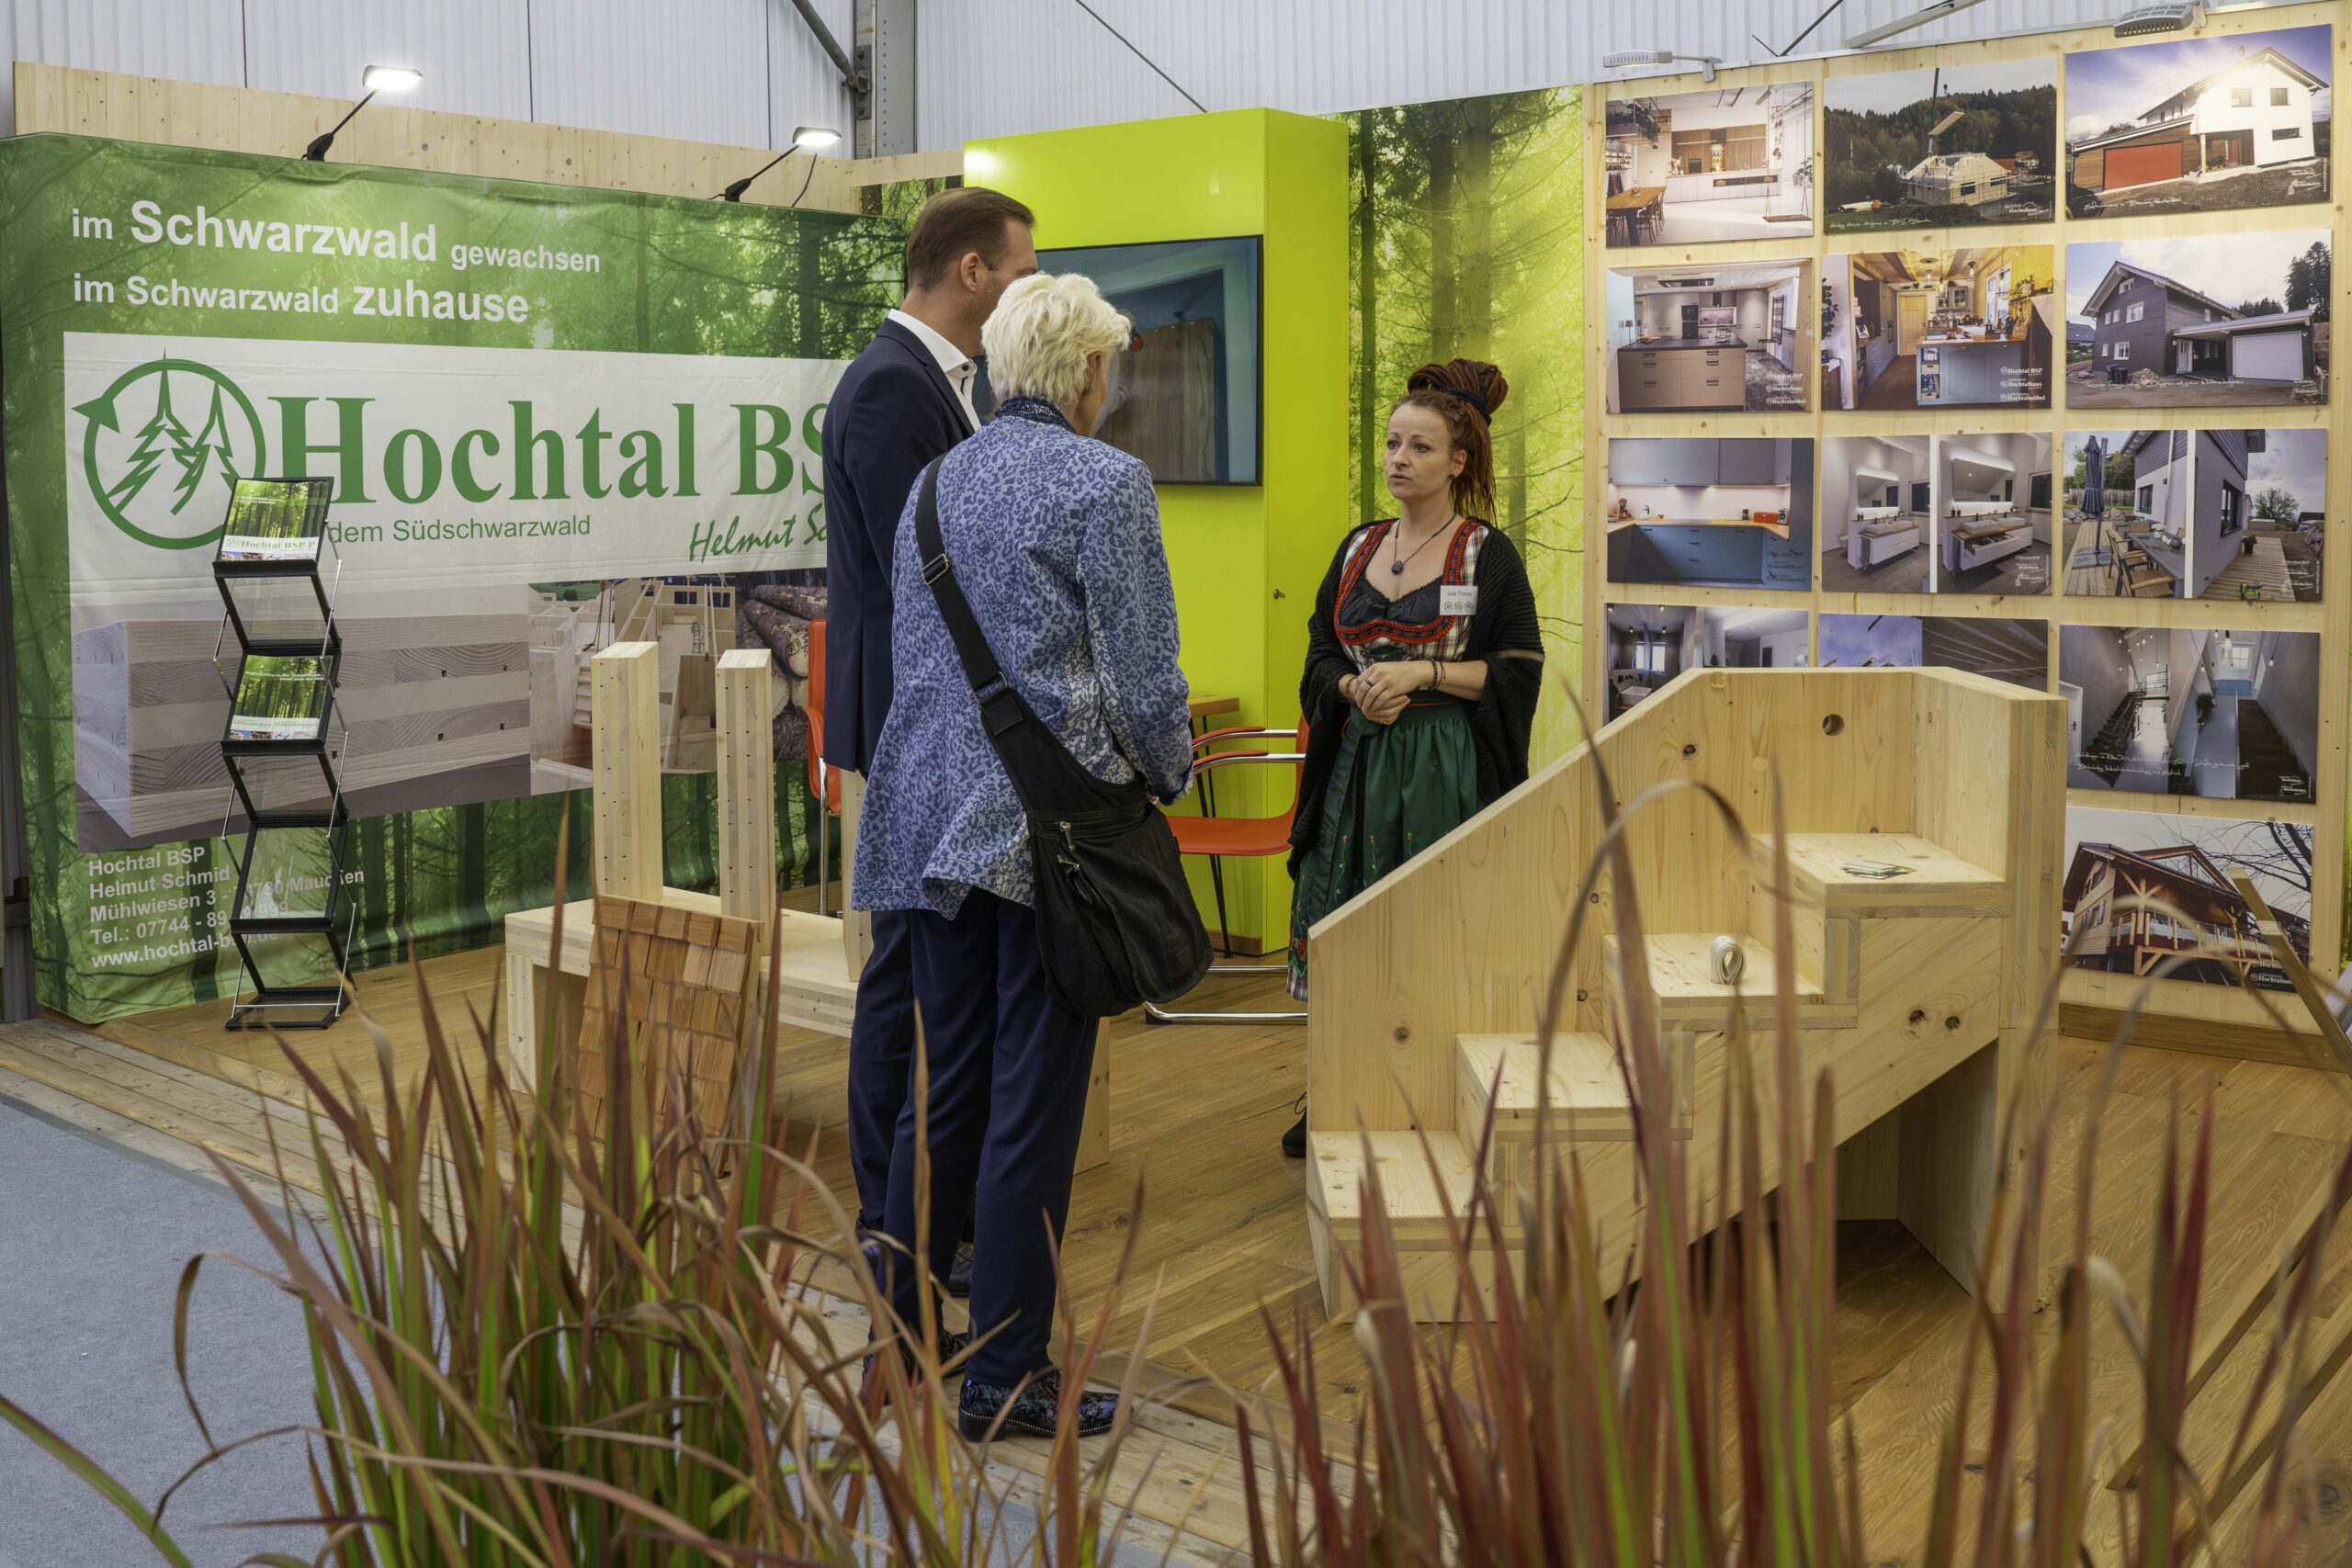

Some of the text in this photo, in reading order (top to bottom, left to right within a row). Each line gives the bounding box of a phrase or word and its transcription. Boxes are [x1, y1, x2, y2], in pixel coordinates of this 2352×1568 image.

[73, 200, 600, 272] im Schwarzwald gewachsen
[74, 273, 529, 323] im Schwarzwald zuhause
[267, 396, 701, 504] Hochtal
[329, 514, 590, 545] dem Südschwarzwald
[689, 514, 797, 564] Helmut
[89, 846, 205, 876] Hochtal BSP
[89, 865, 230, 899] Helmut Schmid
[91, 895, 200, 922] Mühlwiesen
[206, 889, 216, 906] 3
[289, 870, 365, 893] Maucen
[91, 925, 130, 945] Tel.:
[136, 915, 189, 939] 07744
[207, 910, 227, 928] 89
[92, 931, 278, 968] www.hochtal-b.de
